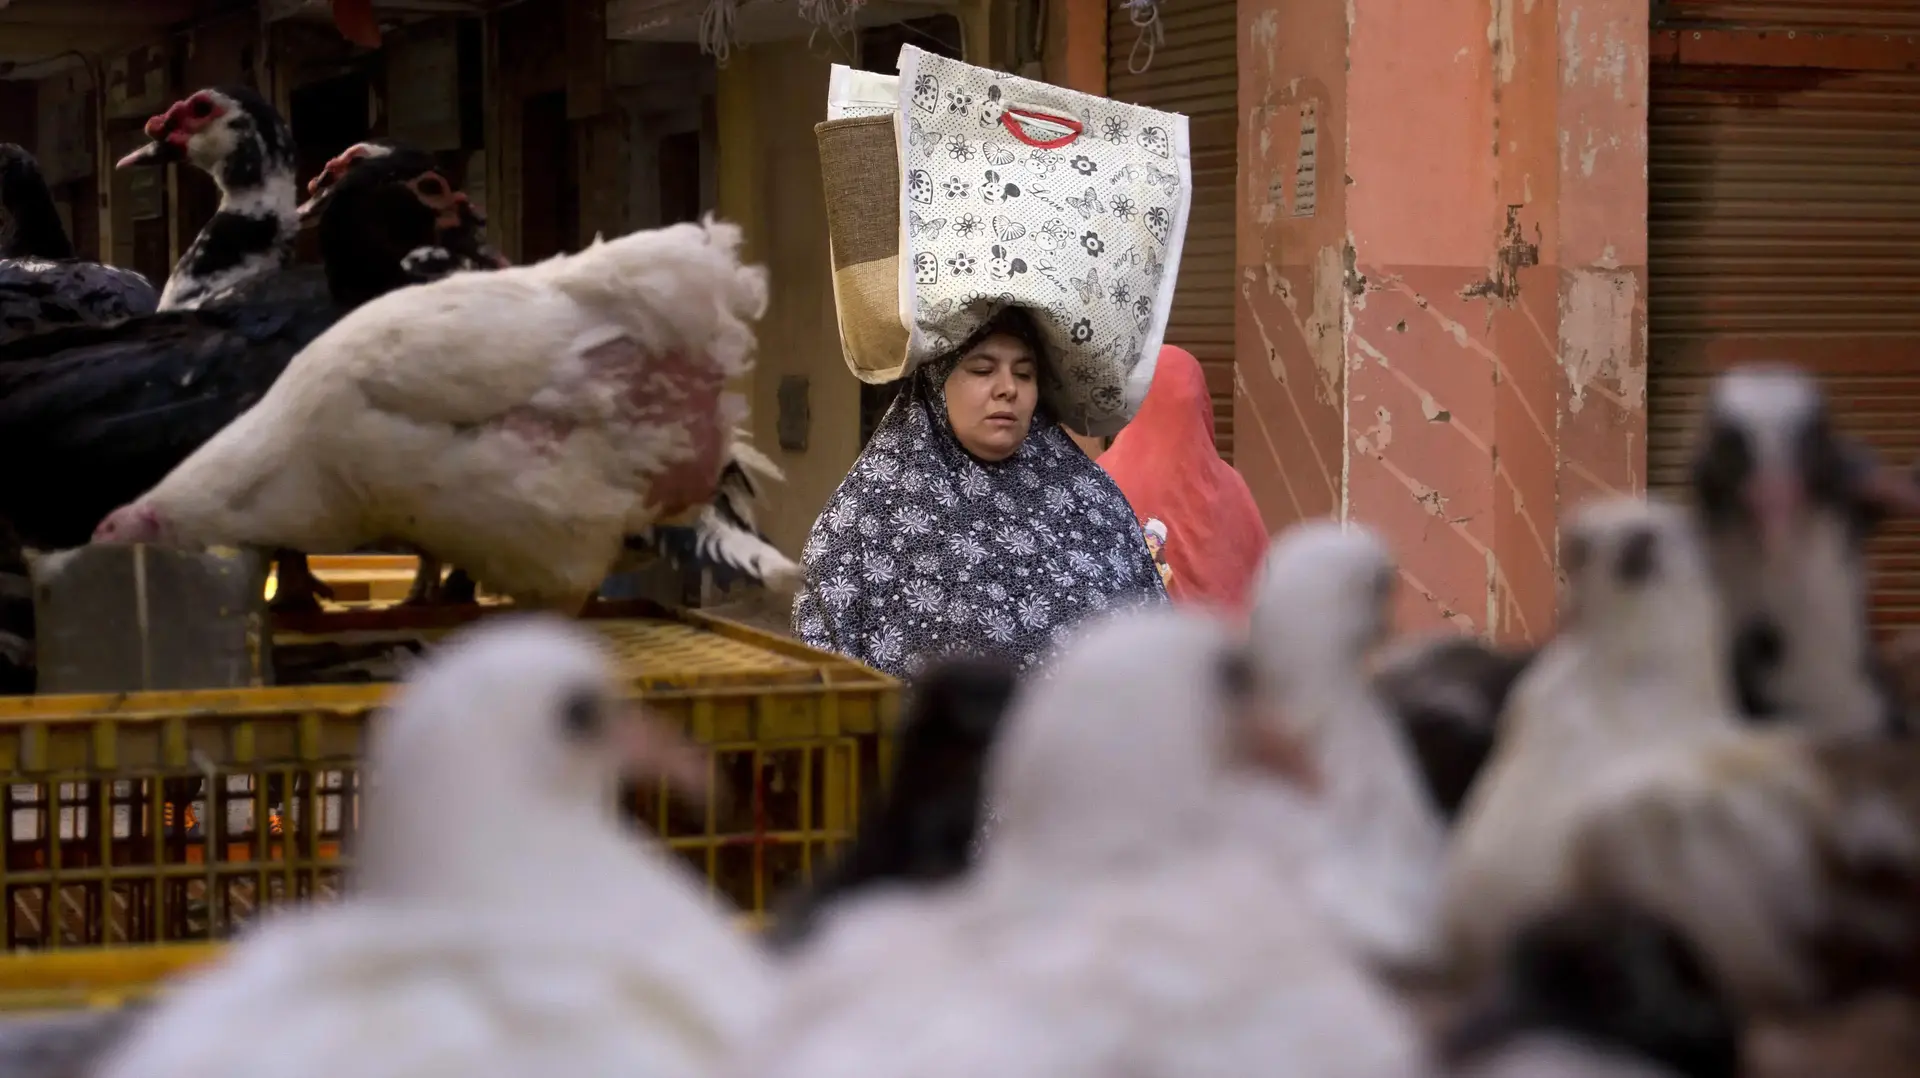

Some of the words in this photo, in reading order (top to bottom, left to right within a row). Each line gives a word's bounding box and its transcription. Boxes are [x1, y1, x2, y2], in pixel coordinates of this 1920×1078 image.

[1025, 183, 1064, 212] Love
[1112, 243, 1140, 270] Love
[1032, 258, 1068, 293] Love
